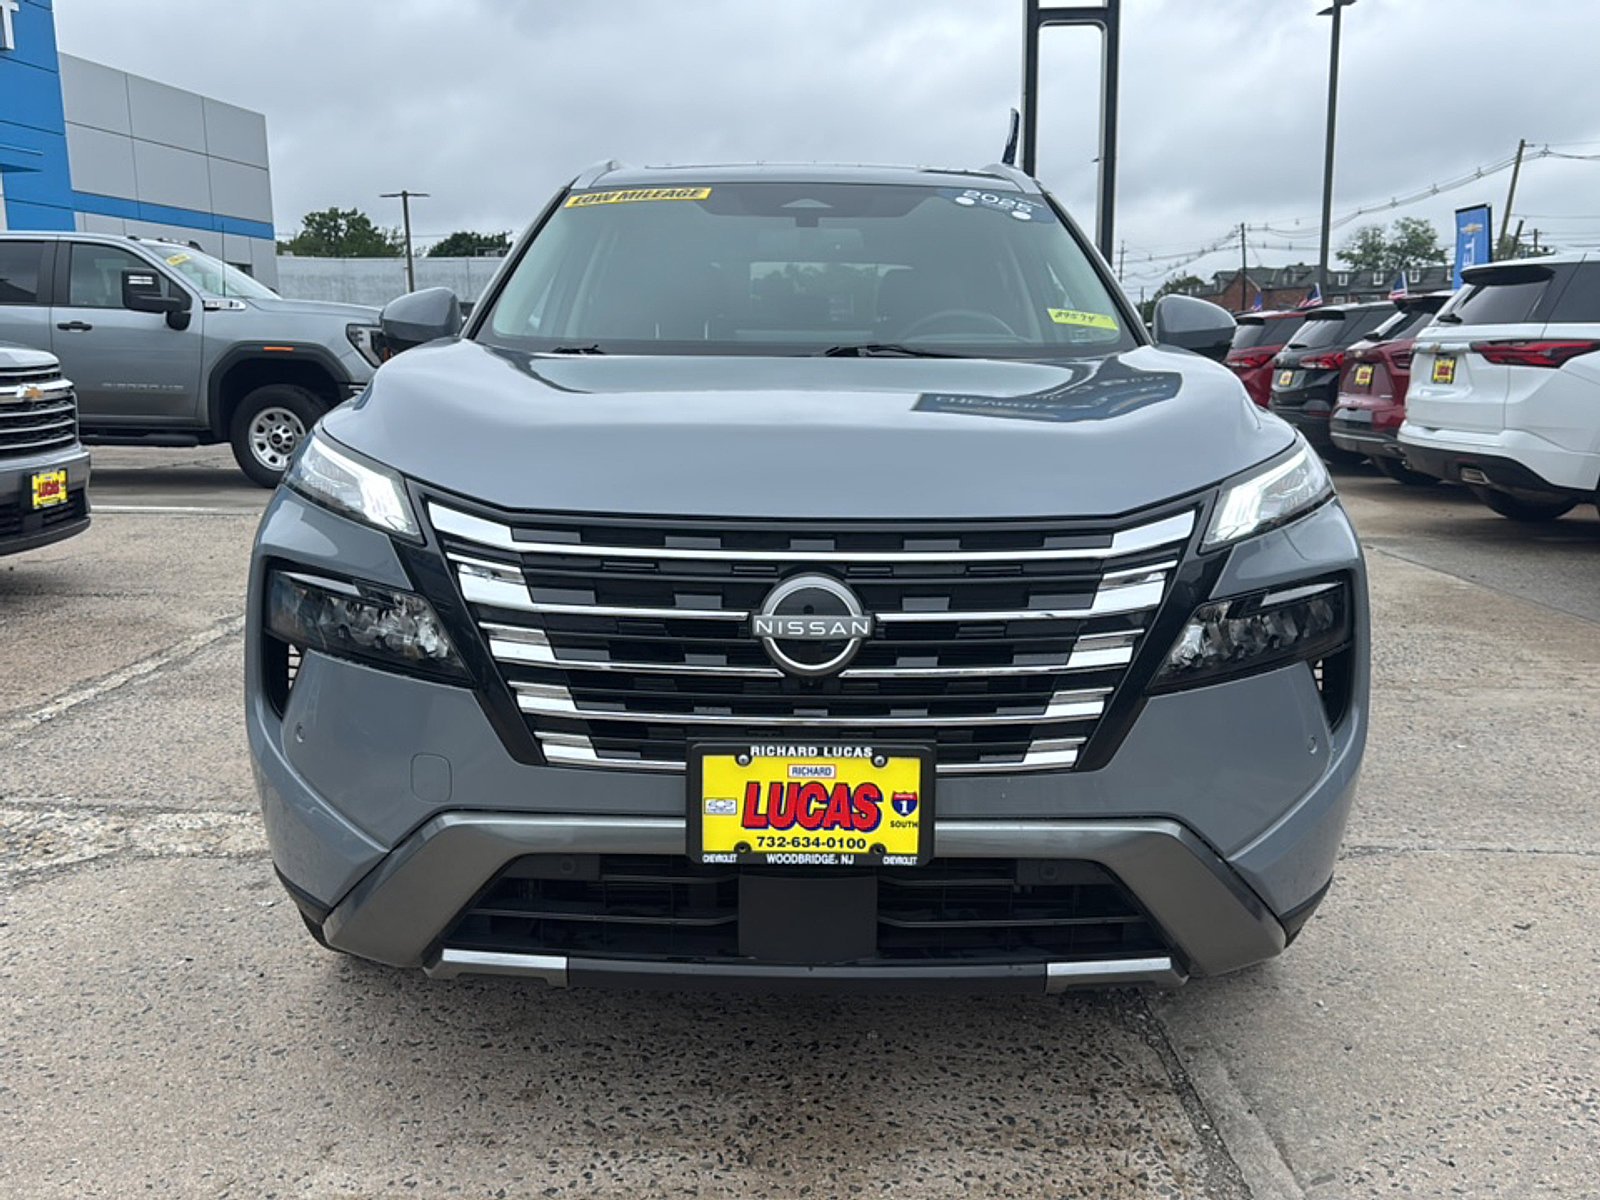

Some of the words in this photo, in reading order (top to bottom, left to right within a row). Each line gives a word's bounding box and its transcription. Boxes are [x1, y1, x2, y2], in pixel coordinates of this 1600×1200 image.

[572, 192, 616, 204] LOW
[616, 189, 698, 201] MILEAGE
[756, 620, 869, 635] NISSAN
[751, 746, 818, 757] RICHARD
[824, 746, 873, 758] LUCAS
[791, 766, 832, 777] RICHARD
[741, 780, 884, 832] LUCAS
[900, 800, 909, 814] 1
[890, 820, 919, 828] SOUTH
[756, 836, 867, 849] 732-634-0100
[840, 854, 855, 865] NJ
